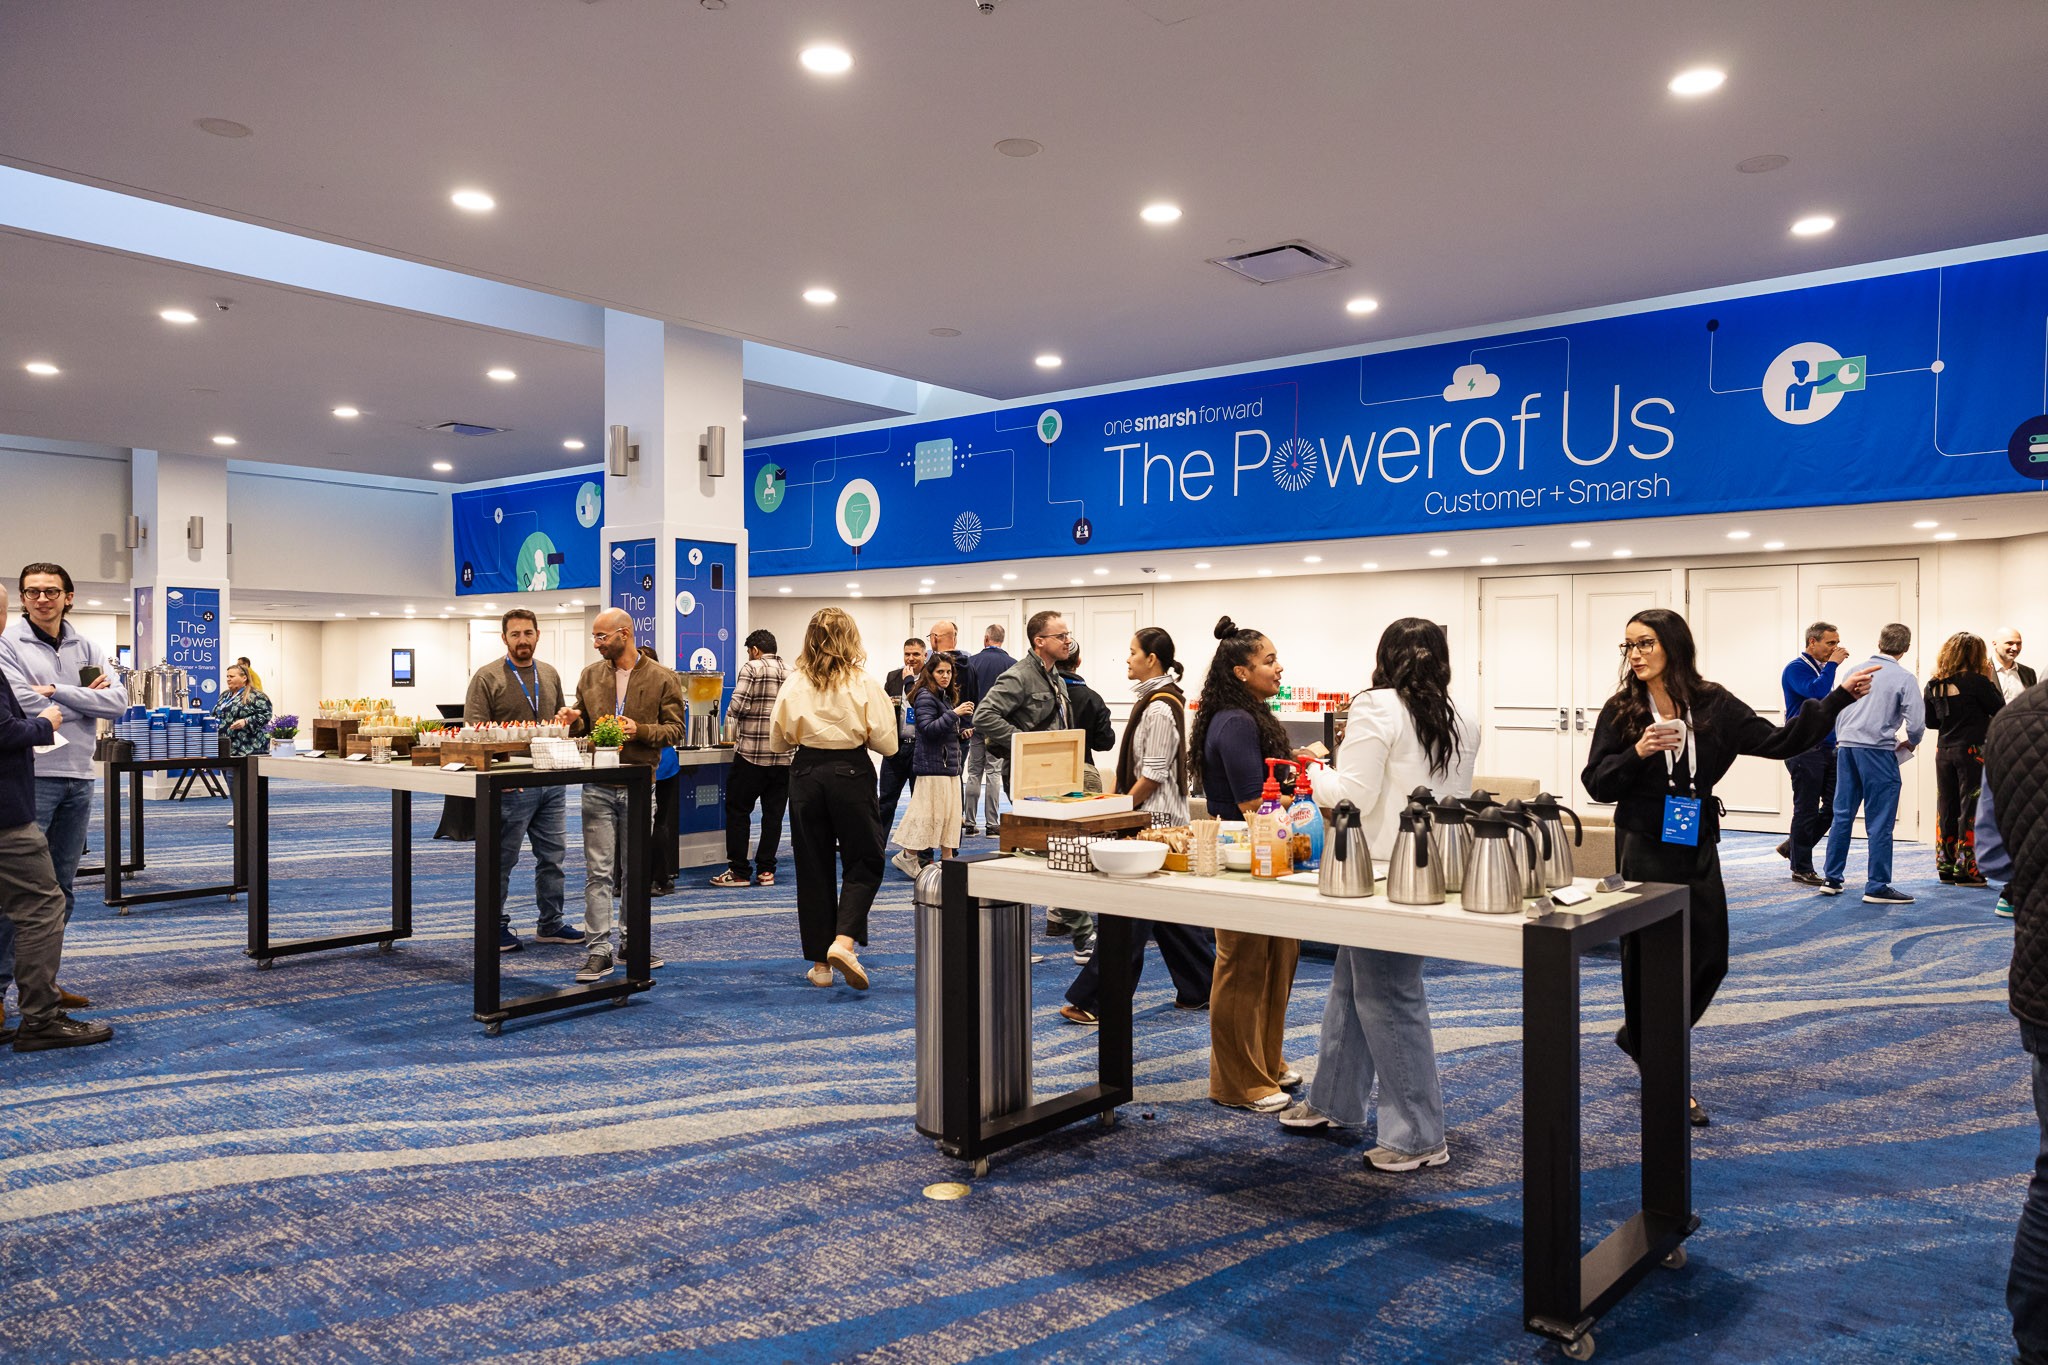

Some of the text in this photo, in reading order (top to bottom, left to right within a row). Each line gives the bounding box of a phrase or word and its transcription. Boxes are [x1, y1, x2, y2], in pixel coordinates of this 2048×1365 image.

[1104, 397, 1263, 436] one smarsh forward
[1104, 384, 1676, 507] The Power of Us
[1424, 487, 1546, 515] Customer
[1568, 473, 1670, 504] Smarsh
[620, 592, 646, 611] The
[177, 620, 207, 635] The
[633, 616, 656, 632] wer
[170, 634, 219, 648] Power
[173, 649, 212, 663] of Us
